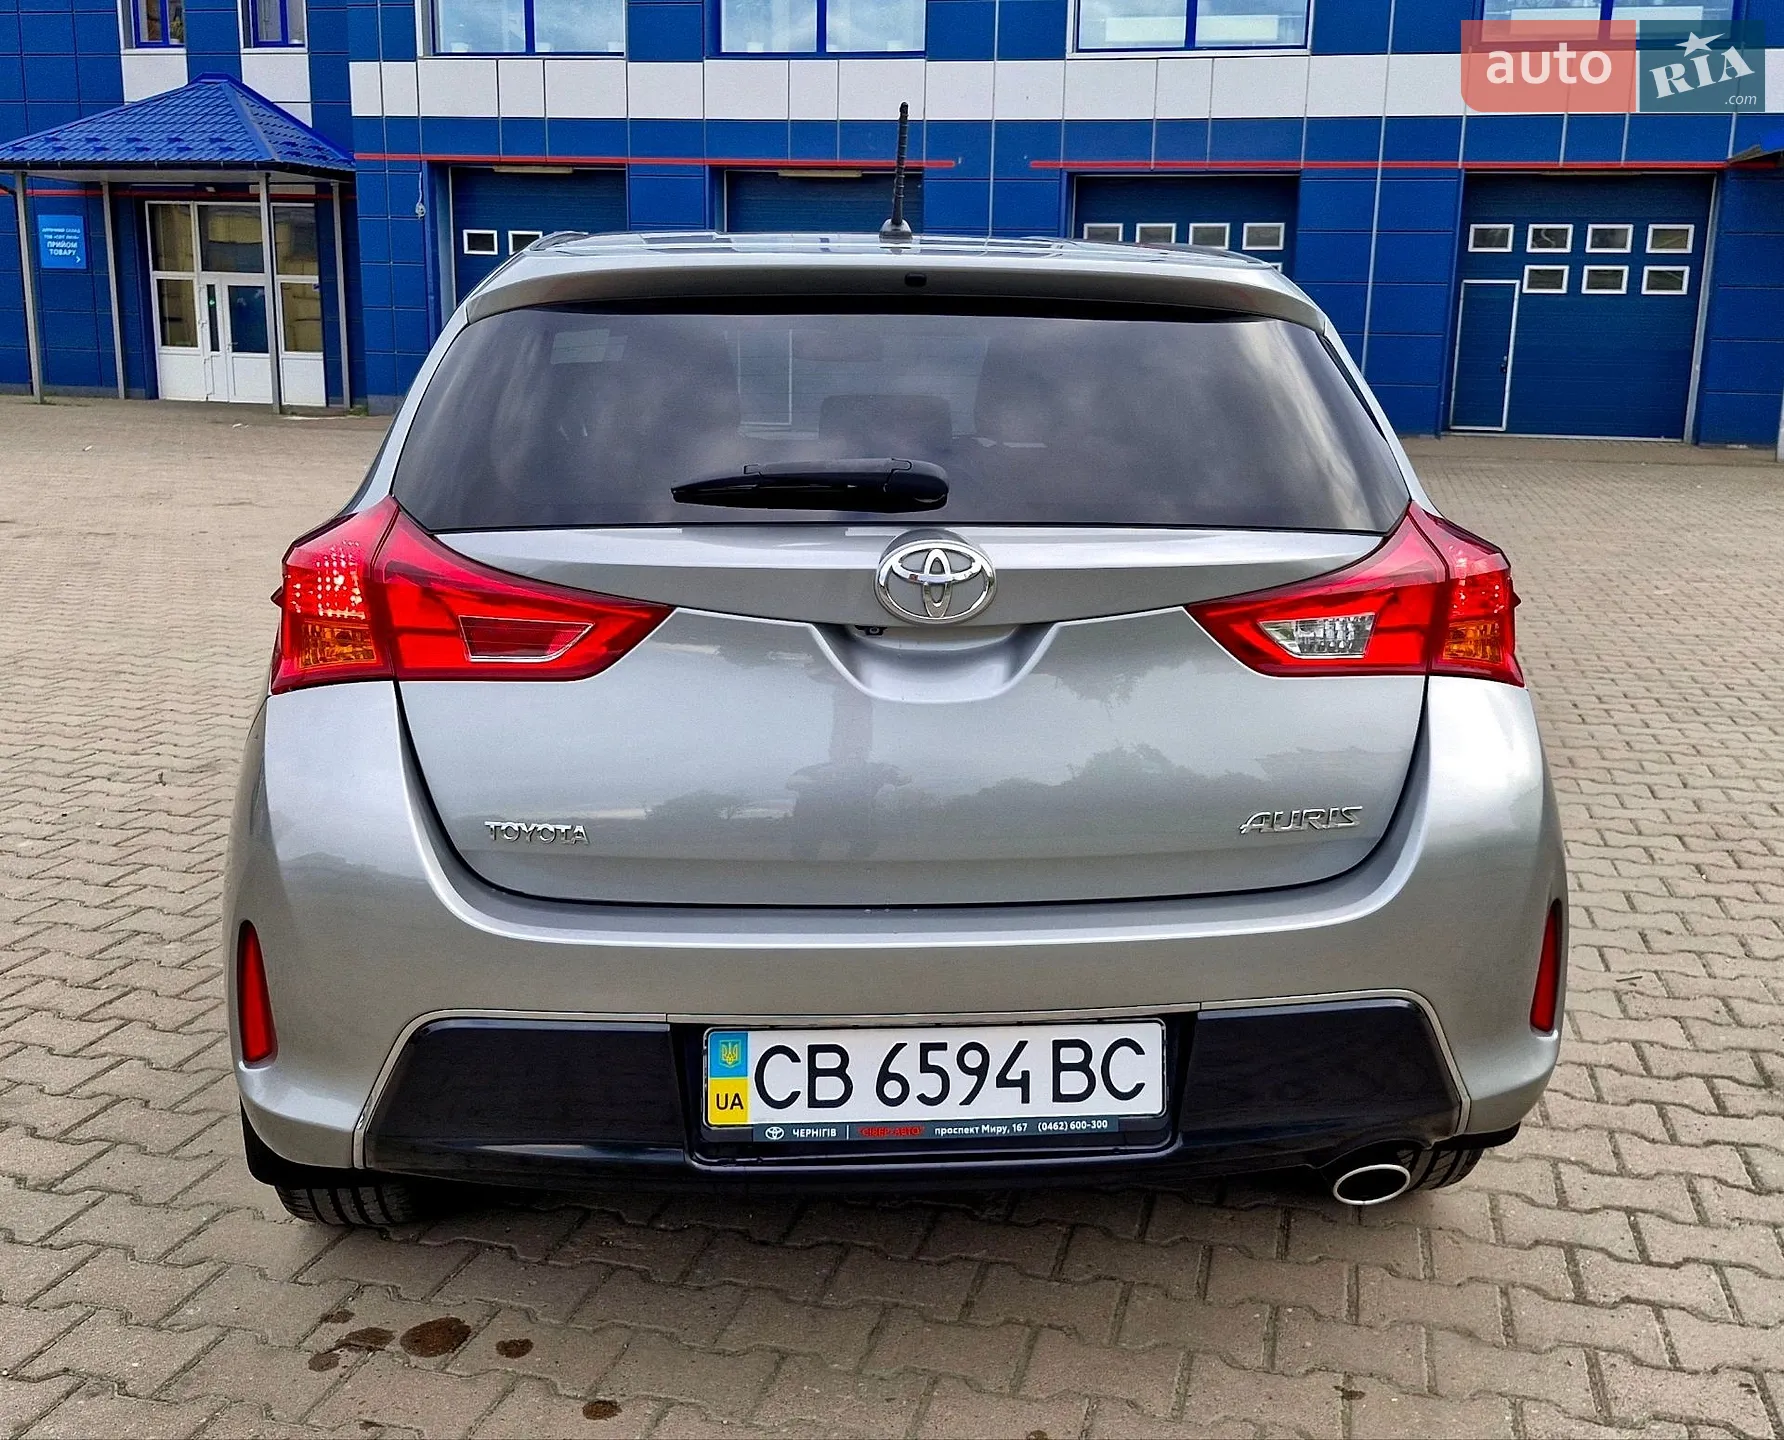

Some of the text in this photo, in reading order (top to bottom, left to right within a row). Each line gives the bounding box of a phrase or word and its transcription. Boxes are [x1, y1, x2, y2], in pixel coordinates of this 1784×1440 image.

[1239, 805, 1363, 834] AURIS
[484, 821, 590, 844] TOYOTA
[754, 1036, 1146, 1110] CB 6594 BC
[716, 1092, 744, 1111] UA
[792, 1127, 837, 1138] ЧЕРНІГІВ
[934, 1125, 979, 1136] проспект
[981, 1124, 1010, 1135] Миру,
[1012, 1123, 1028, 1132] 167
[1037, 1121, 1068, 1132] (0462)
[1069, 1120, 1108, 1130] 600-300
